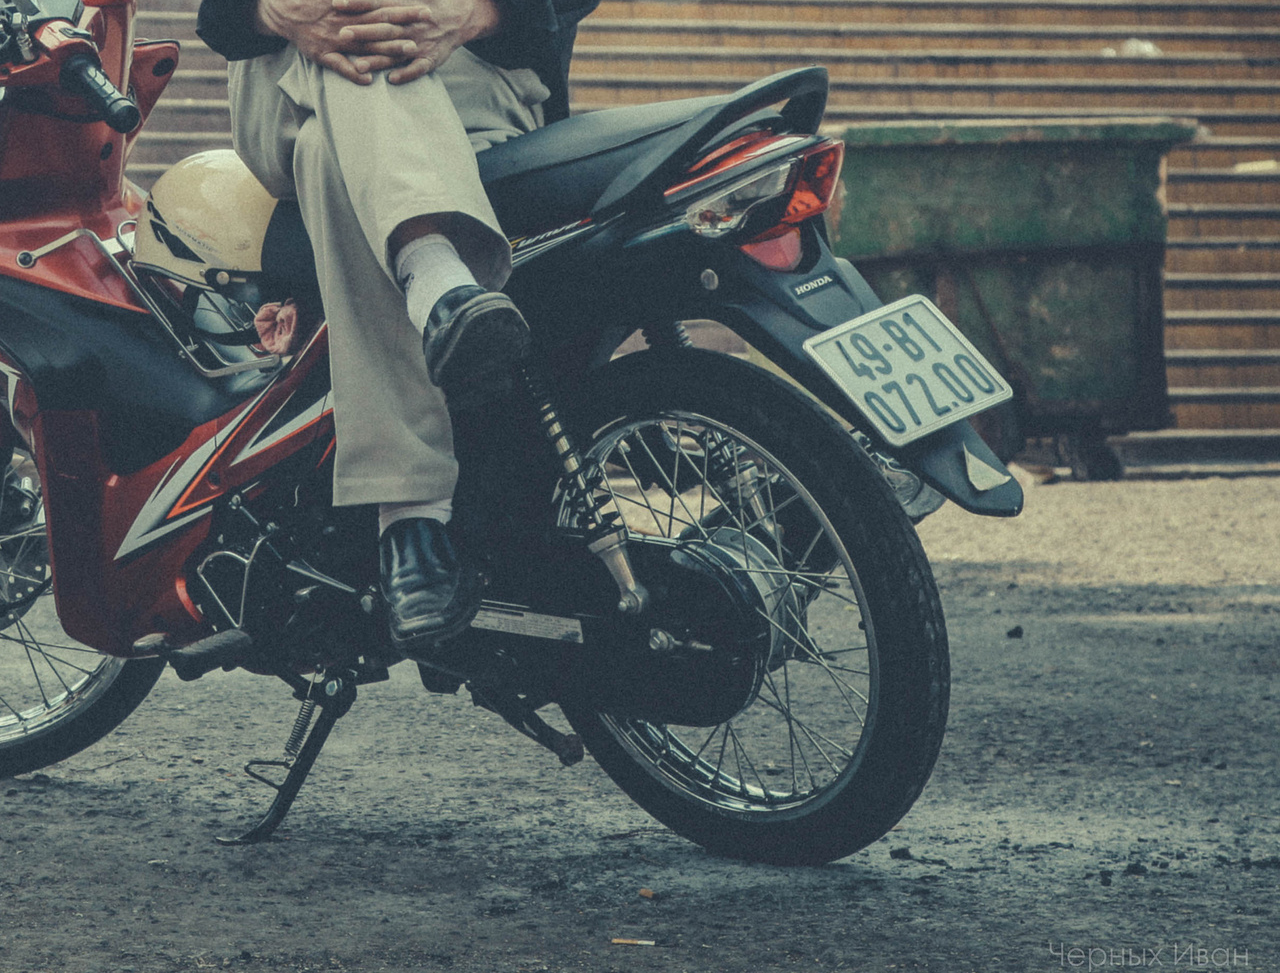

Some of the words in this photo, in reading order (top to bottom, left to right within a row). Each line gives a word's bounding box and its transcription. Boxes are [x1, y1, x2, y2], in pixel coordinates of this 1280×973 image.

[794, 275, 833, 296] HONDA
[834, 311, 943, 382] 49-B1
[863, 353, 997, 434] 072.00
